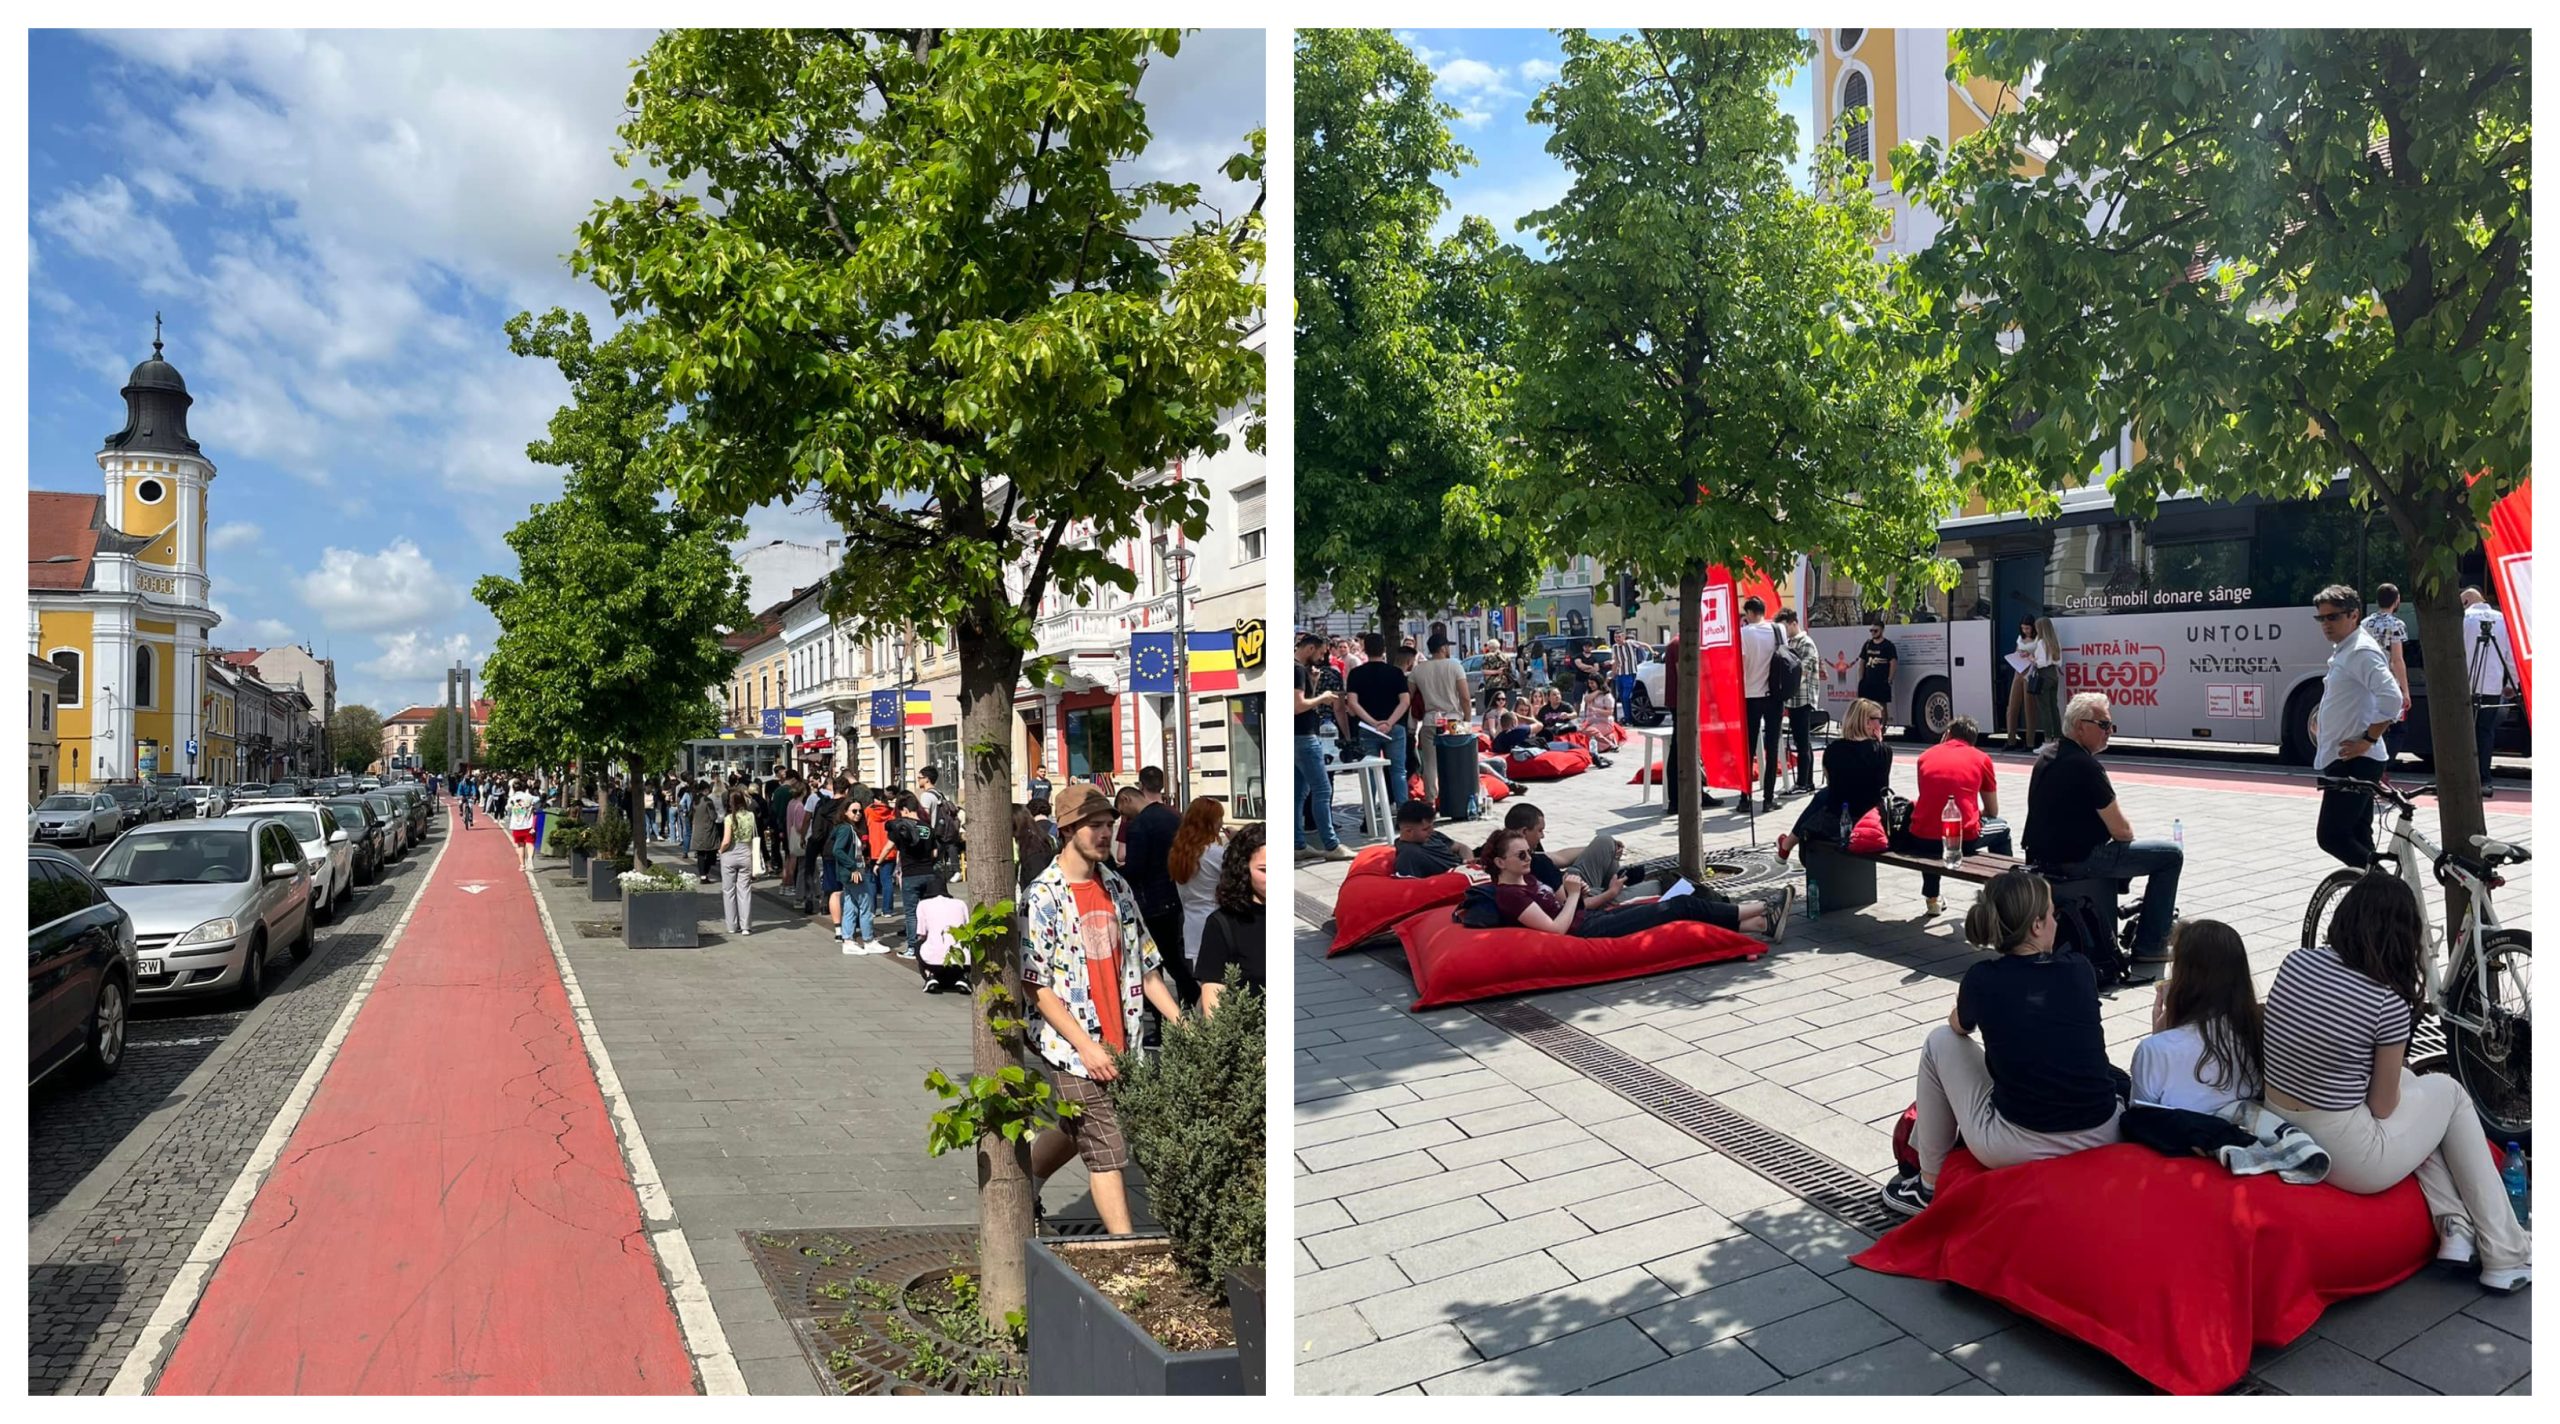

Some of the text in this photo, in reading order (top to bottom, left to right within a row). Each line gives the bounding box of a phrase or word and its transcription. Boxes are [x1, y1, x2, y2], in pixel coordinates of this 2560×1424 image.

[2065, 585, 2252, 608] Centru mobil donare sânge
[2187, 624, 2282, 643] UNTOLD
[1237, 629, 1264, 659] NP
[2081, 639, 2139, 655] INTRĂ ÎN
[2065, 662, 2158, 687] BLOOD
[2189, 654, 2282, 675] NEVERSEA
[2066, 689, 2159, 706] NWORK
[138, 961, 158, 973] RW
